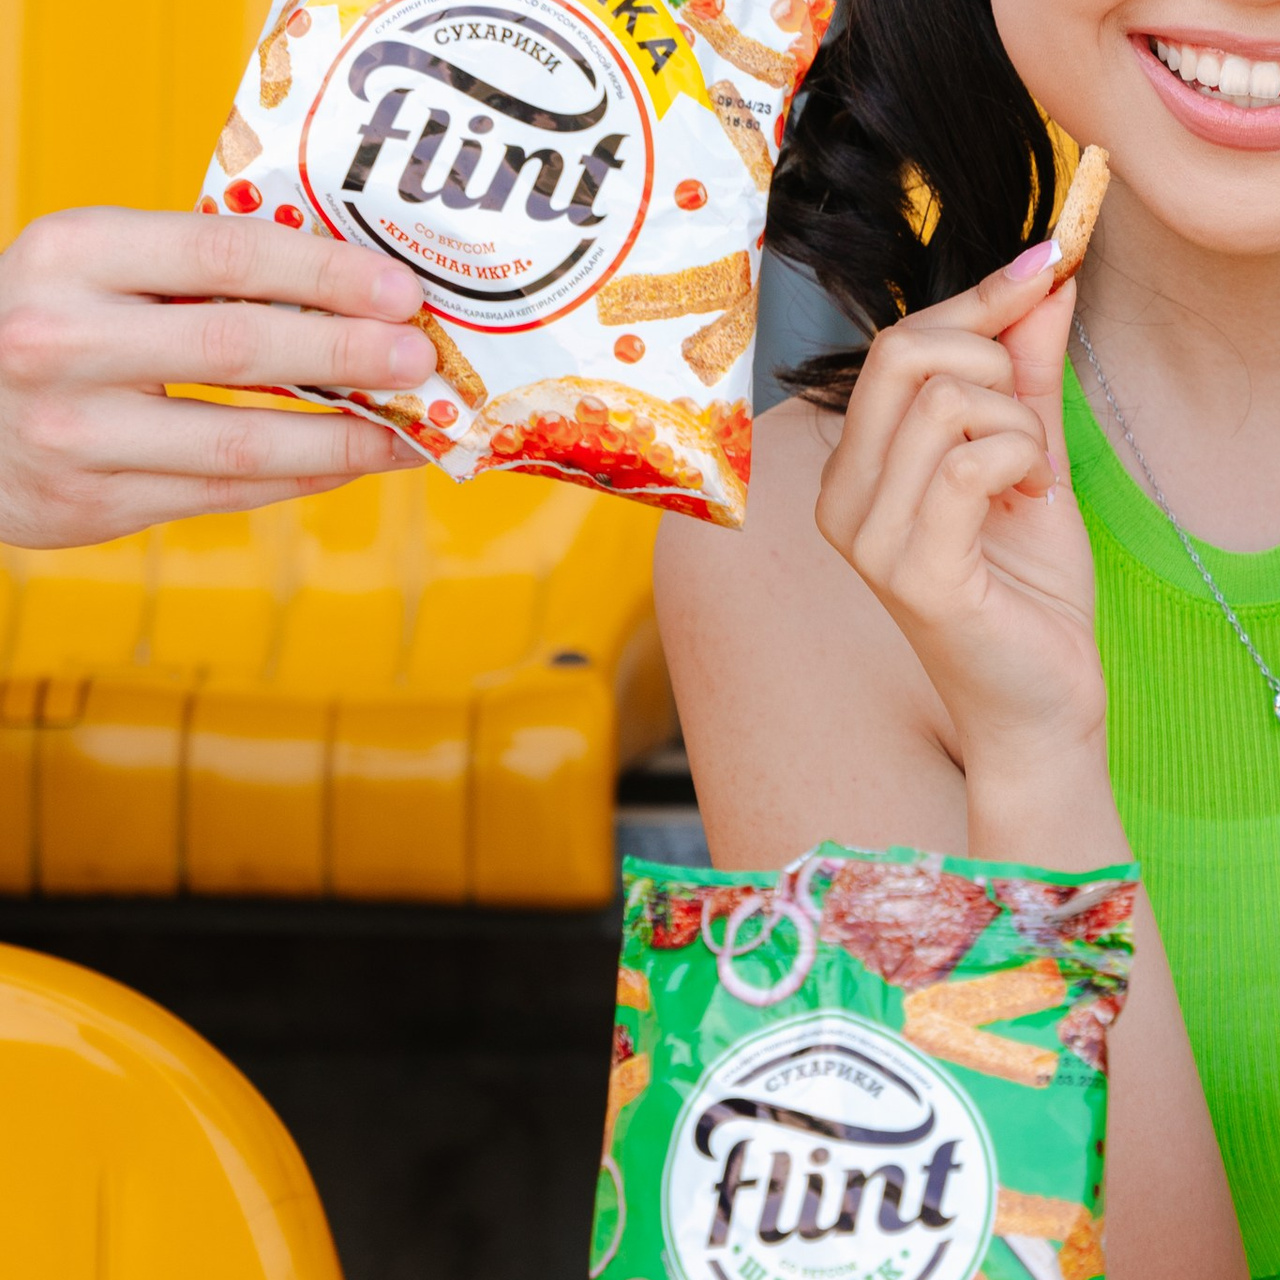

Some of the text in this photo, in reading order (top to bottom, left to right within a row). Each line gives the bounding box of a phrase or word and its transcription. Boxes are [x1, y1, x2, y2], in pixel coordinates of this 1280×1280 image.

[434, 23, 562, 74] СУХАРИКИ
[341, 87, 630, 227] flint
[384, 221, 527, 280] КРАСНАЯ ИКРА
[414, 222, 496, 255] СО ВКУСОМ
[764, 1060, 885, 1100] СУХАРИКИ
[706, 1138, 964, 1248] flint
